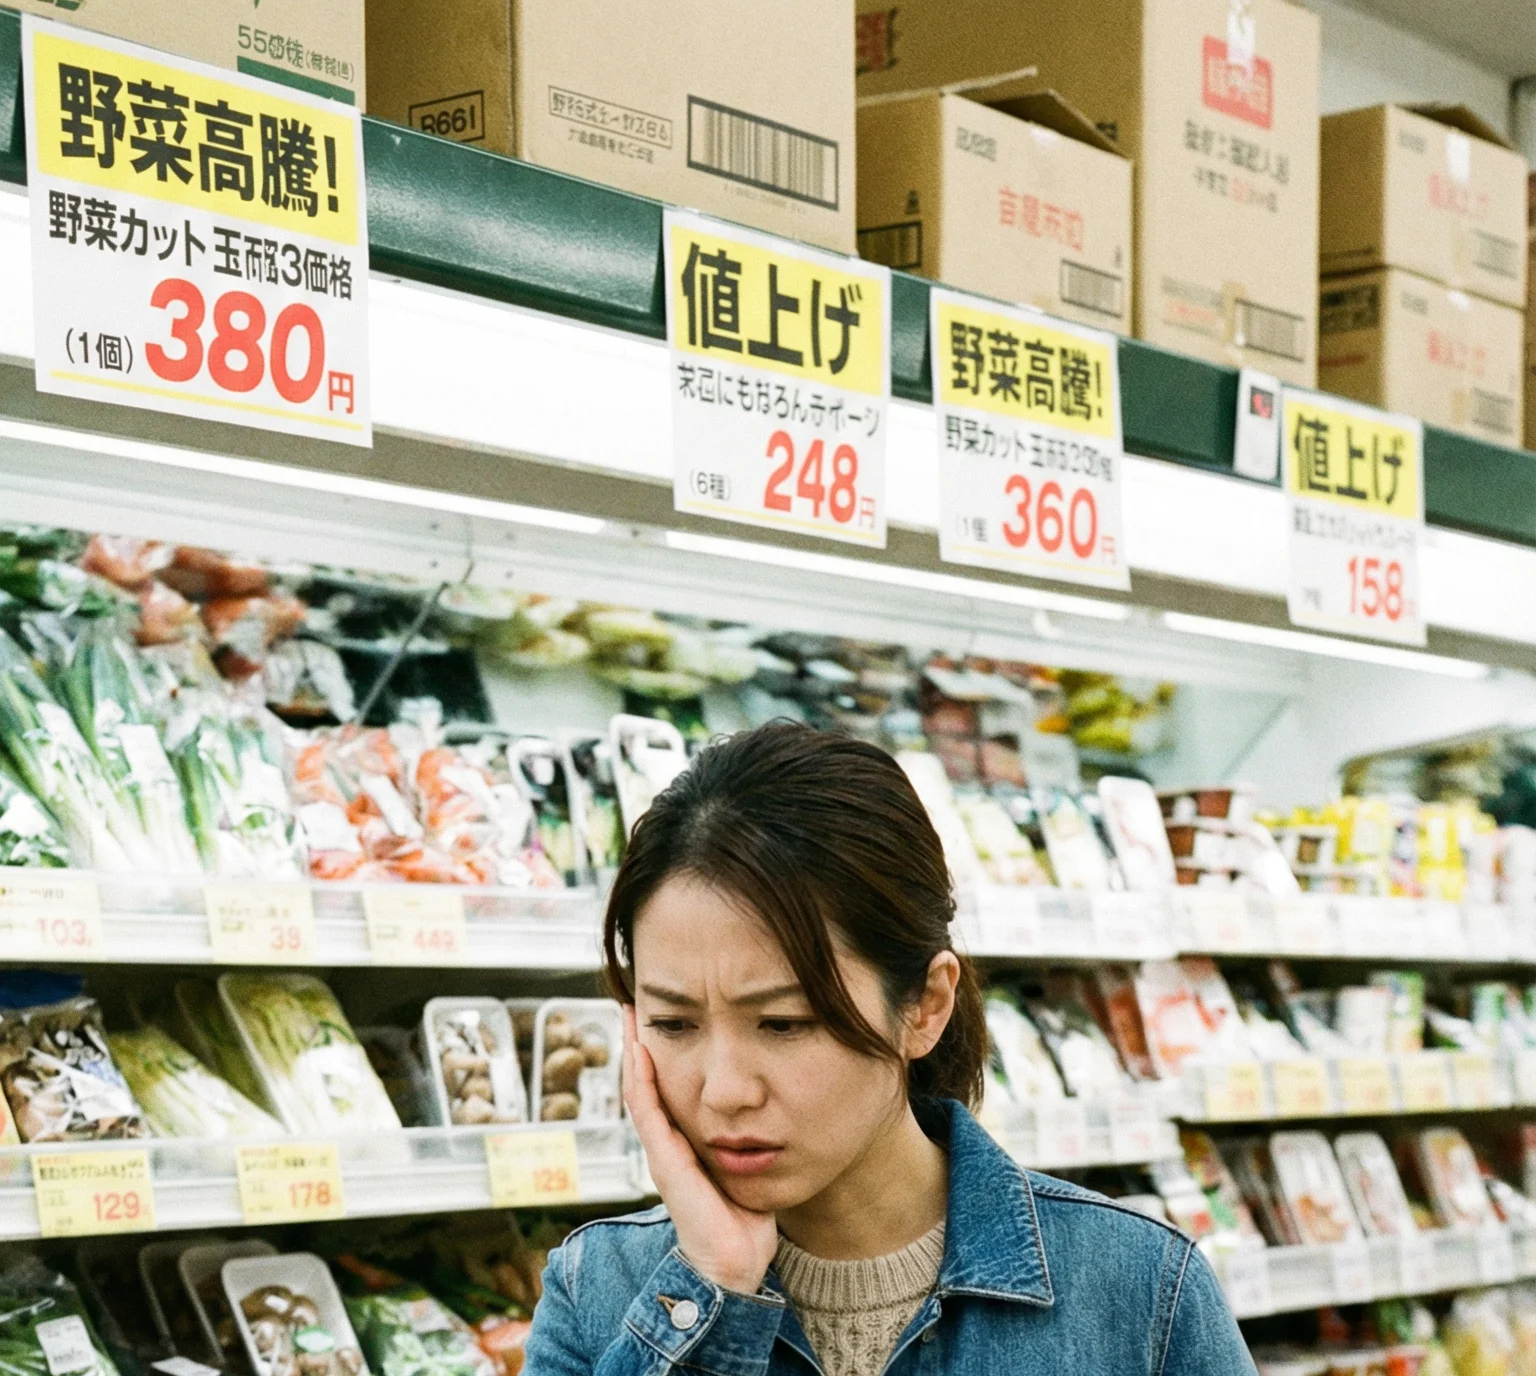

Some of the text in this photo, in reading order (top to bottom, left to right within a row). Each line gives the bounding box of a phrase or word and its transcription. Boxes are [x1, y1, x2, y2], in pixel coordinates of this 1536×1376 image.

[58, 63, 339, 217] 野菜高騰!
[66, 328, 133, 373] (1個)
[145, 278, 354, 414] 380円
[681, 241, 862, 375] 値上げ
[1293, 413, 1405, 505] 値上げ
[94, 1190, 141, 1222] 129
[290, 1180, 332, 1208] 178
